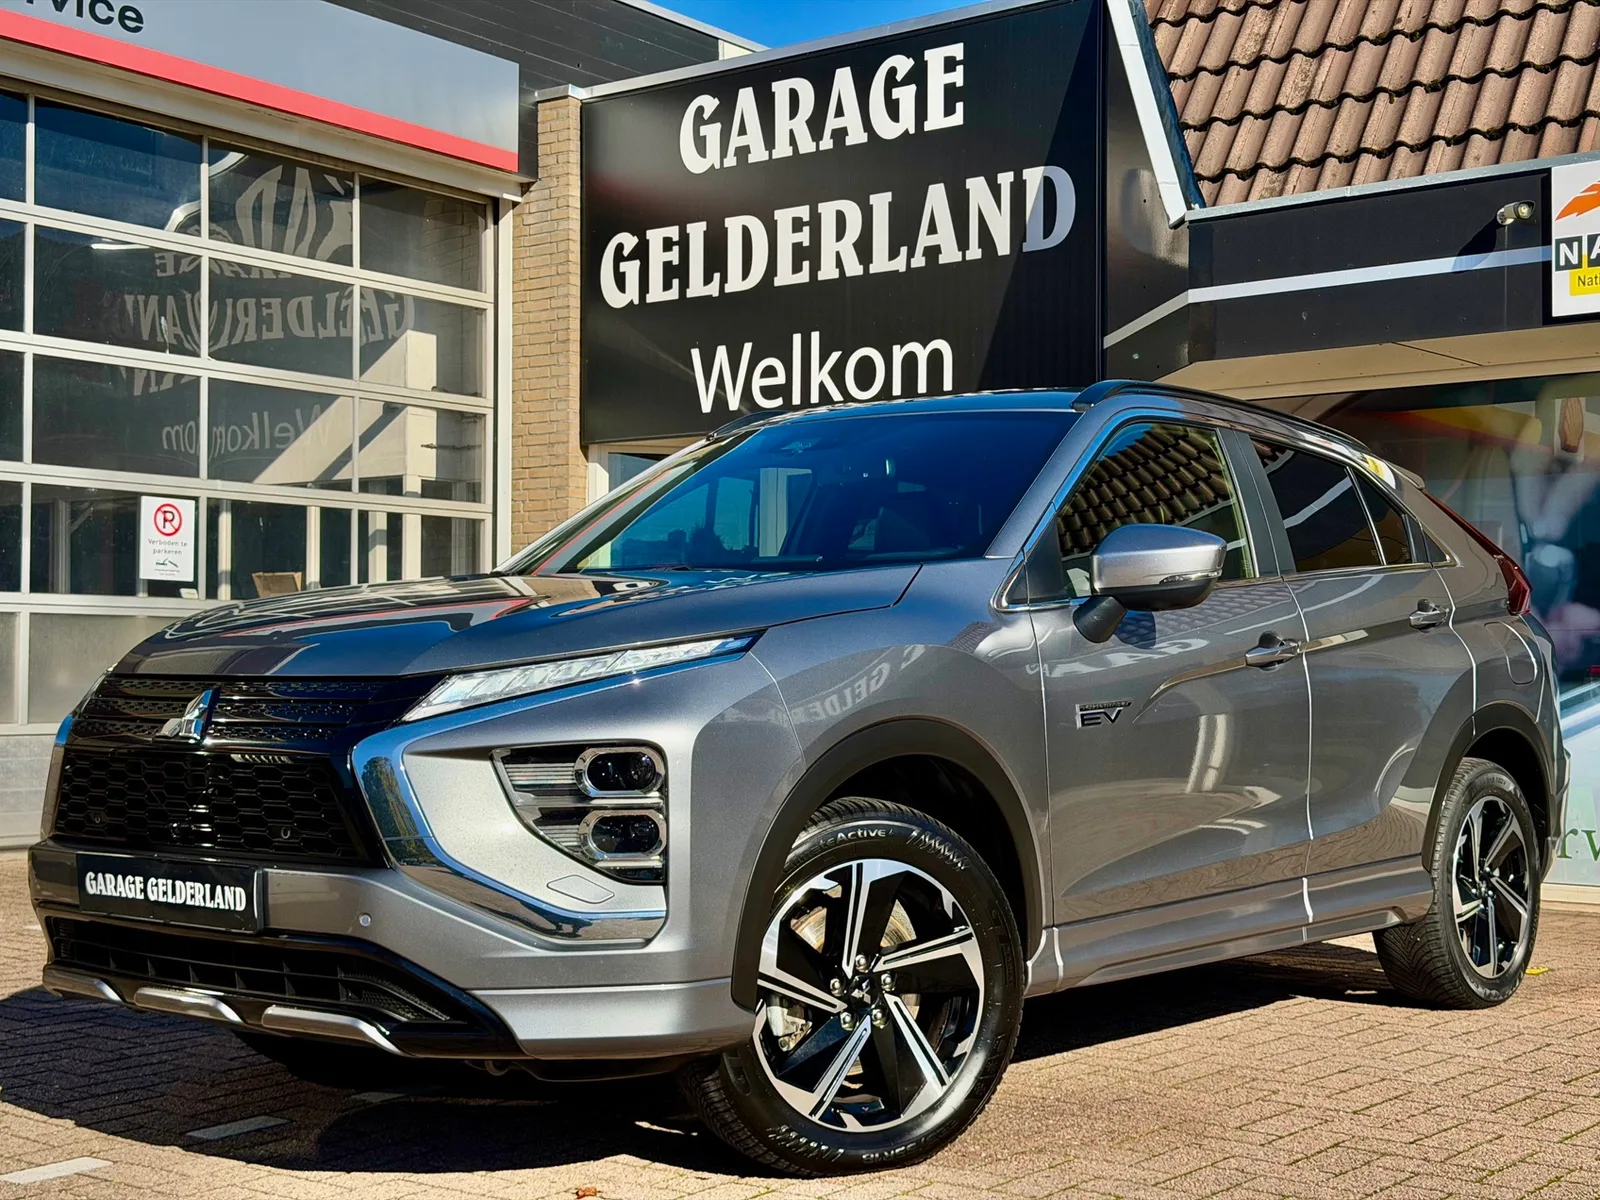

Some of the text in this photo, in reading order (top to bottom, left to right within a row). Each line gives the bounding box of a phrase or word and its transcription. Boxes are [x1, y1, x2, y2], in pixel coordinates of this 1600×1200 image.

[679, 42, 964, 174] GARAGE
[600, 165, 1076, 309] GELDERLAND
[690, 330, 954, 414] Welkom
[148, 538, 179, 547] Verboden
[1076, 709, 1123, 727] EV
[85, 871, 246, 911] GARAGE GELDERLAND
